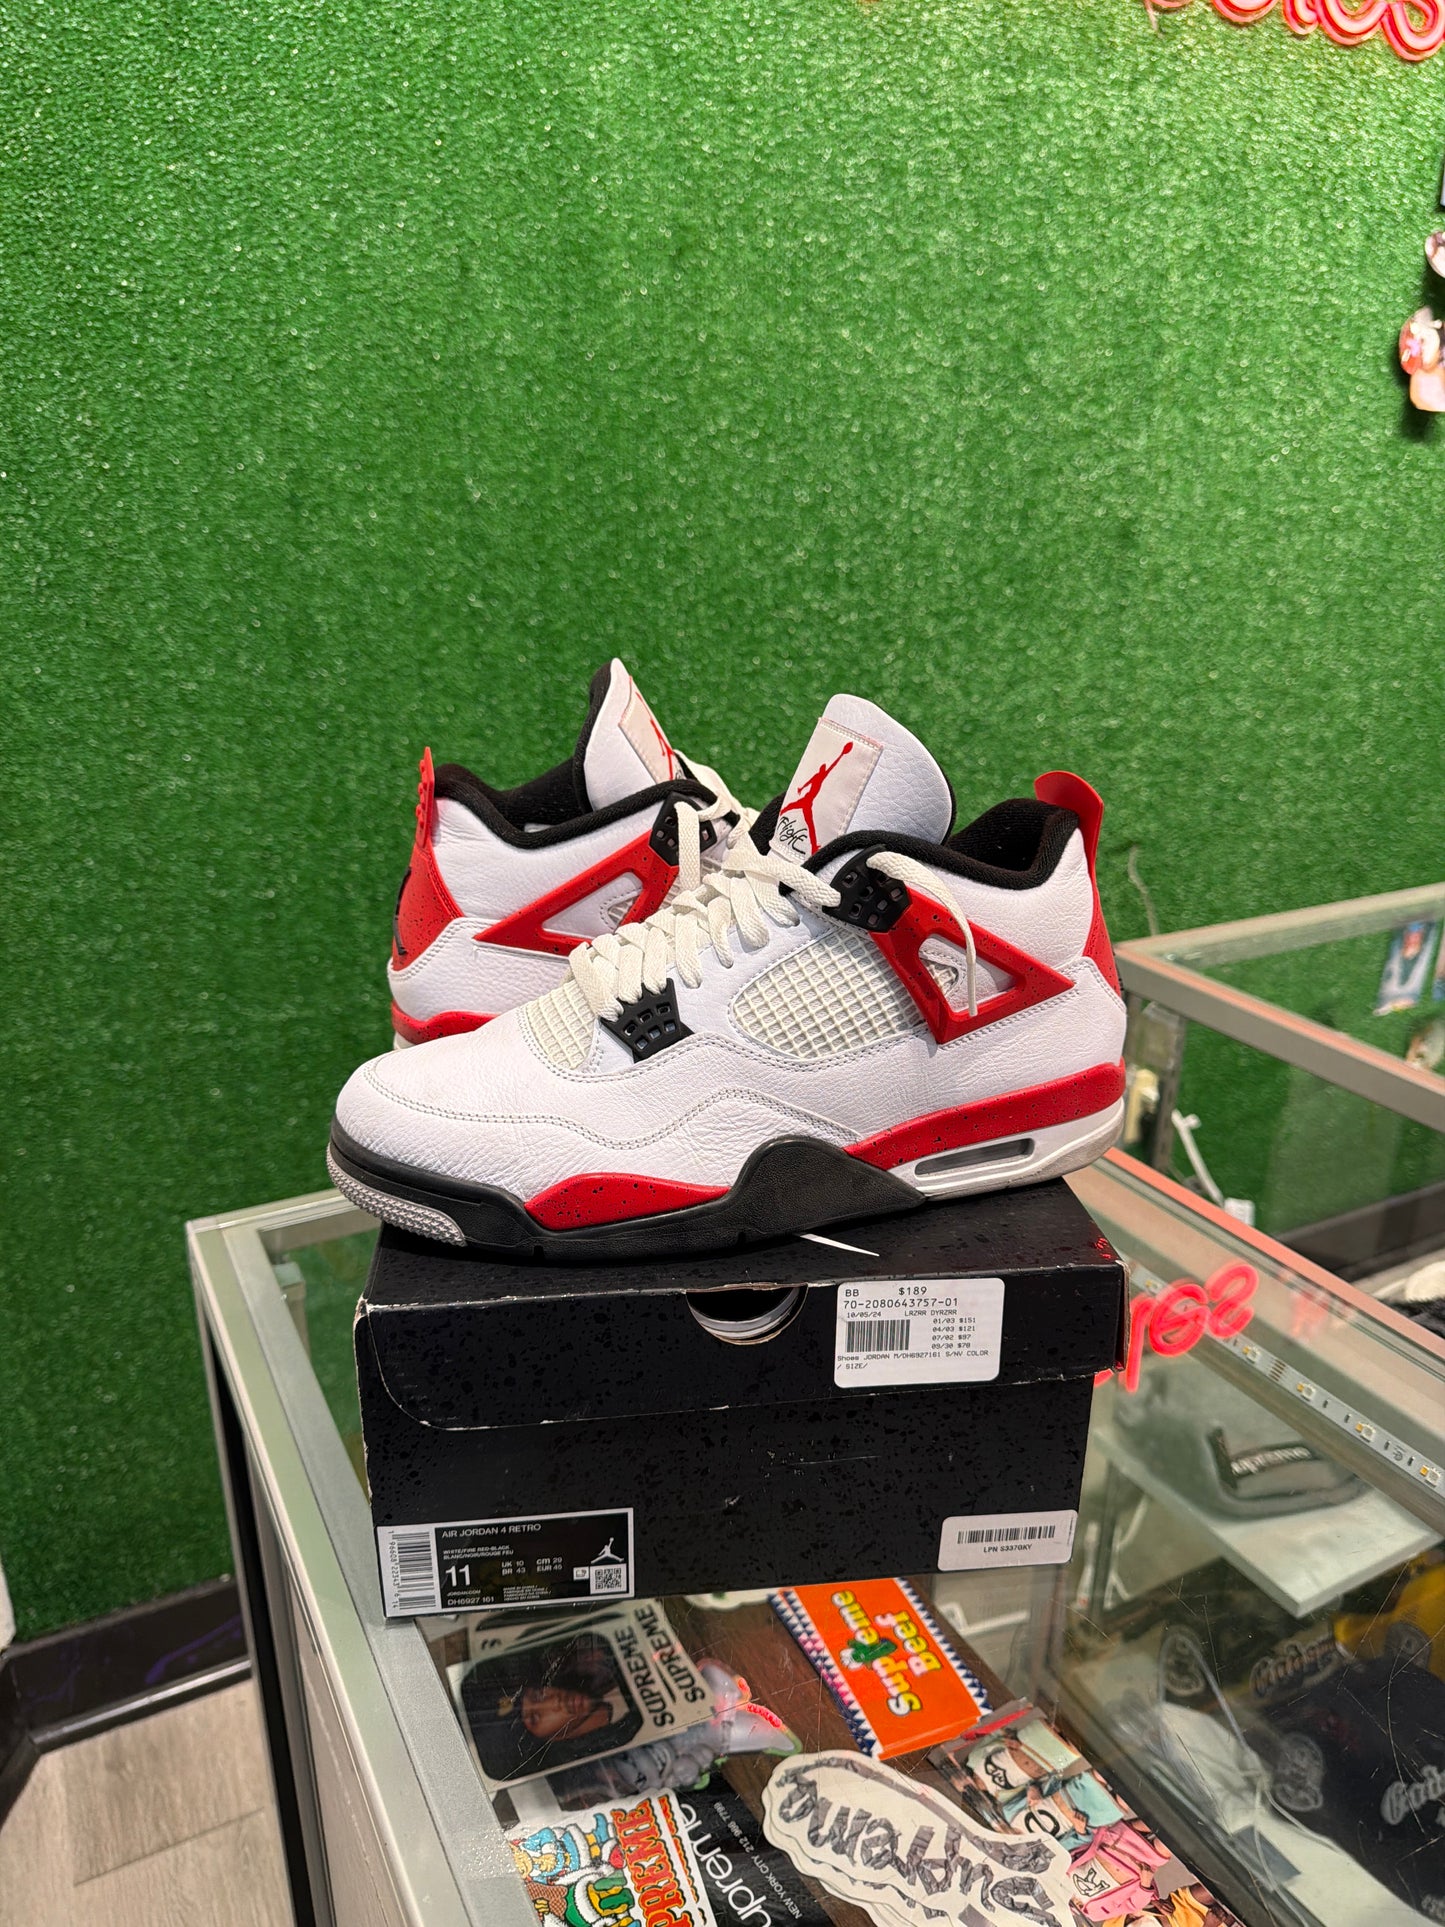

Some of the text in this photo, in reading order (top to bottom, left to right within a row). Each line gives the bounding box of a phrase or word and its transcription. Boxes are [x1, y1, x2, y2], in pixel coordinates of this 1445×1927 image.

[776, 816, 808, 855] Flight
[845, 1286, 928, 1297] BB $189
[843, 1297, 958, 1310] 70-2080643757-01
[958, 1316, 976, 1324] $151
[837, 1354, 860, 1362] Shoes
[441, 1523, 542, 1538] AIR JORDAN 4 RETRO
[536, 1558, 551, 1566] cm
[445, 1564, 471, 1587] 11
[634, 1604, 706, 1704] SUPREME
[614, 1624, 676, 1728] SUPREME
[751, 1853, 770, 1875] CITY
[765, 1872, 787, 1899] YORK
[783, 1896, 803, 1920] NEW
